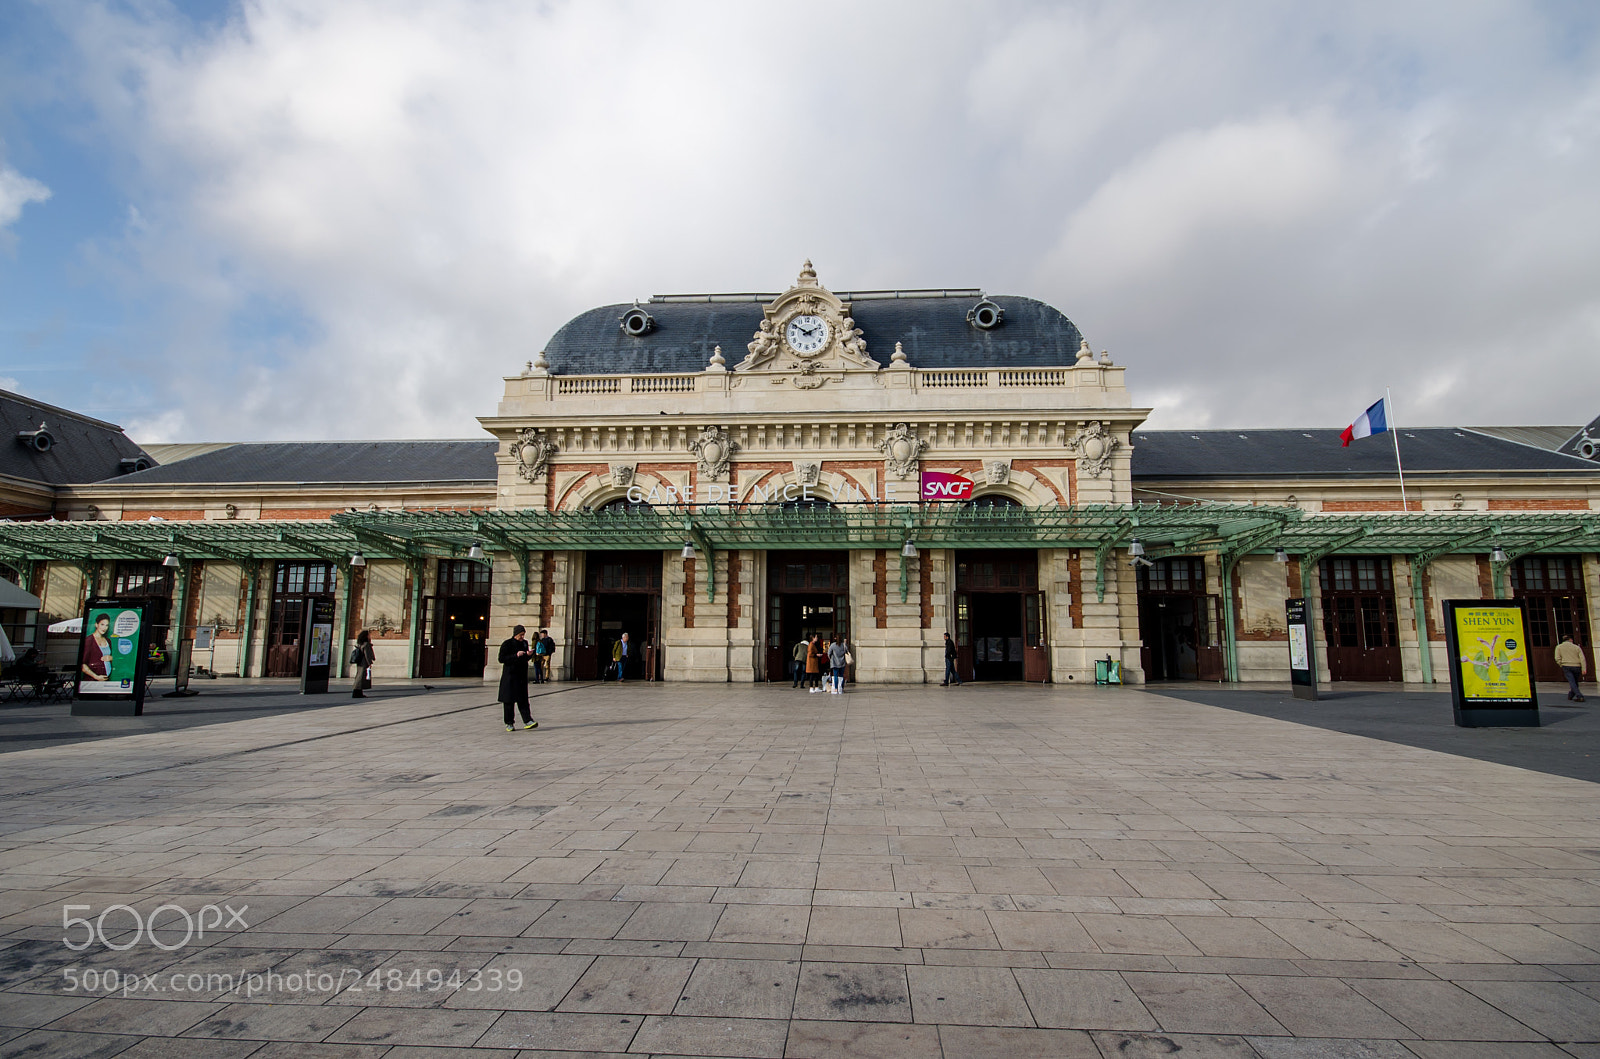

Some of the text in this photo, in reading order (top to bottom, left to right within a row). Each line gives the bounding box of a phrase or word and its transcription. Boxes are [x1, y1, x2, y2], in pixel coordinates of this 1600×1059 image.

[626, 482, 897, 504] GARE DE NICE VILLE
[924, 482, 972, 496] SNCF
[1463, 617, 1515, 626] SHEN YUN
